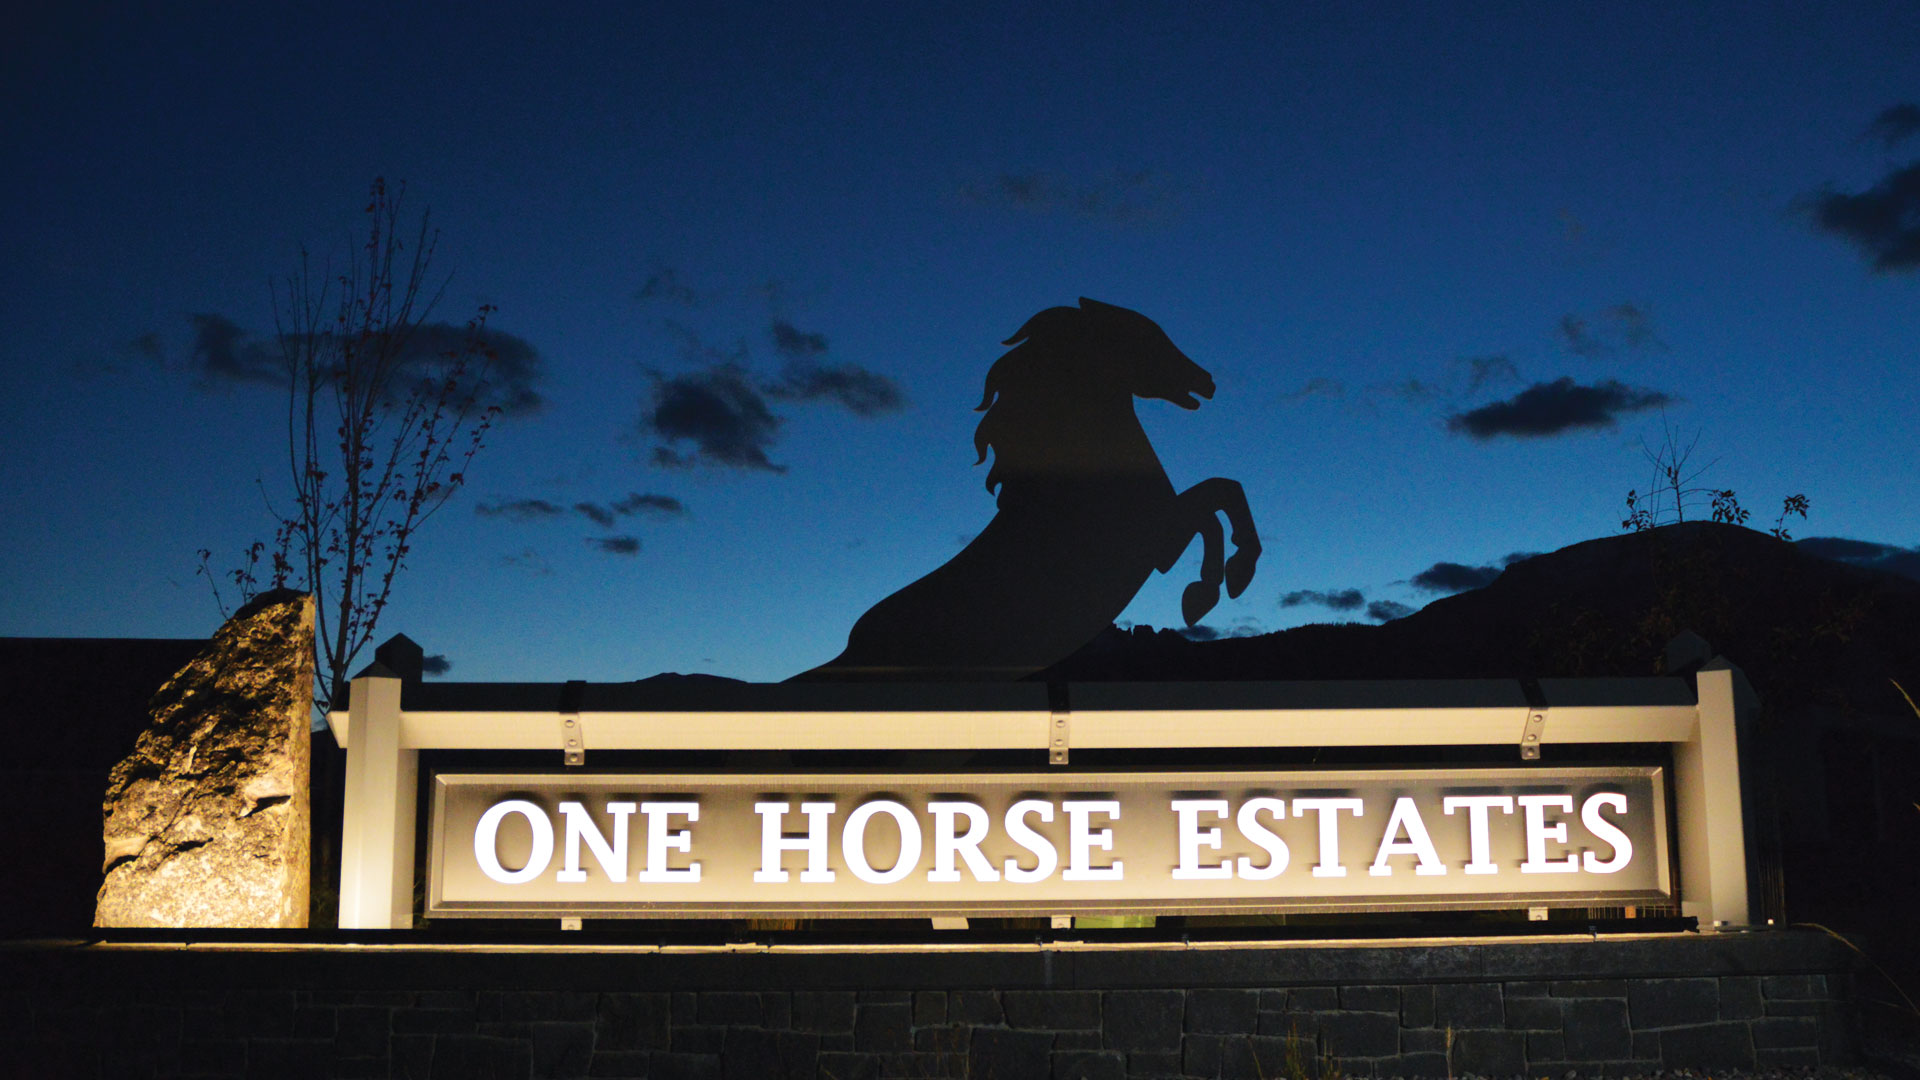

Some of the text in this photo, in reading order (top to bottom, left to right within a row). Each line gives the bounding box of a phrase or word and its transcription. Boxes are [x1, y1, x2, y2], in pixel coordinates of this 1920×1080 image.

[474, 793, 1634, 885] ONE HORSE ESTATES
